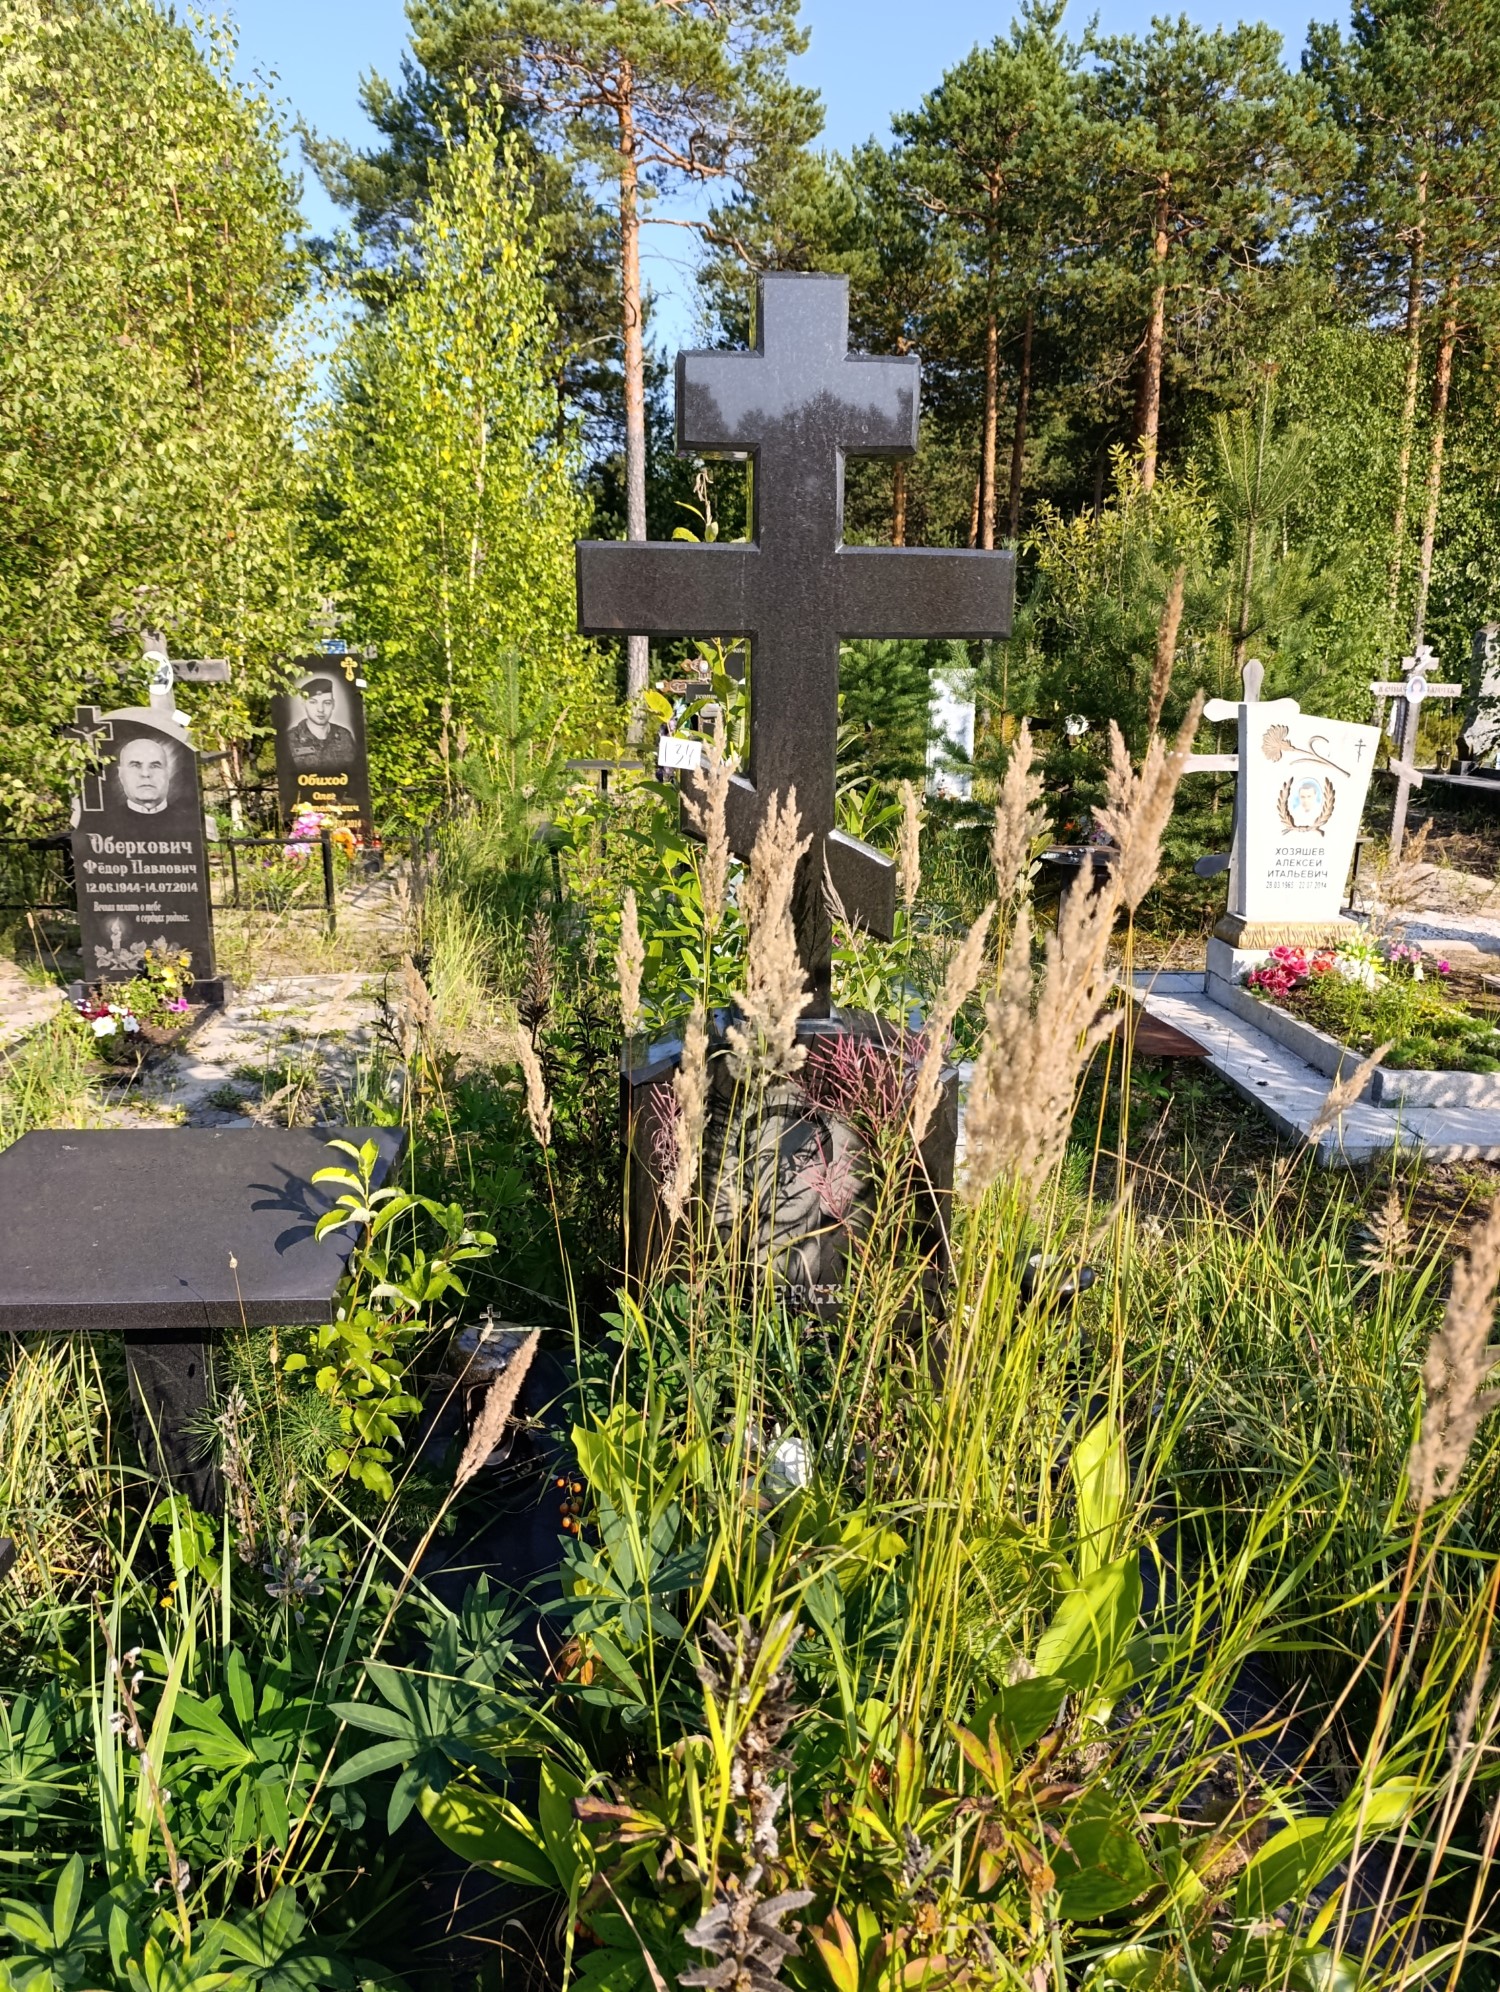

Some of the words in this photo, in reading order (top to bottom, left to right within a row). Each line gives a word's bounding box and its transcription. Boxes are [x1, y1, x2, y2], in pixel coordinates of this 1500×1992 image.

[297, 772, 349, 786] Обиход
[86, 833, 193, 859] Оберкович
[83, 859, 128, 877] Фёдор
[130, 859, 197, 874] Павлович
[1267, 869, 1328, 878] ИТАЛЬЕВИЧ
